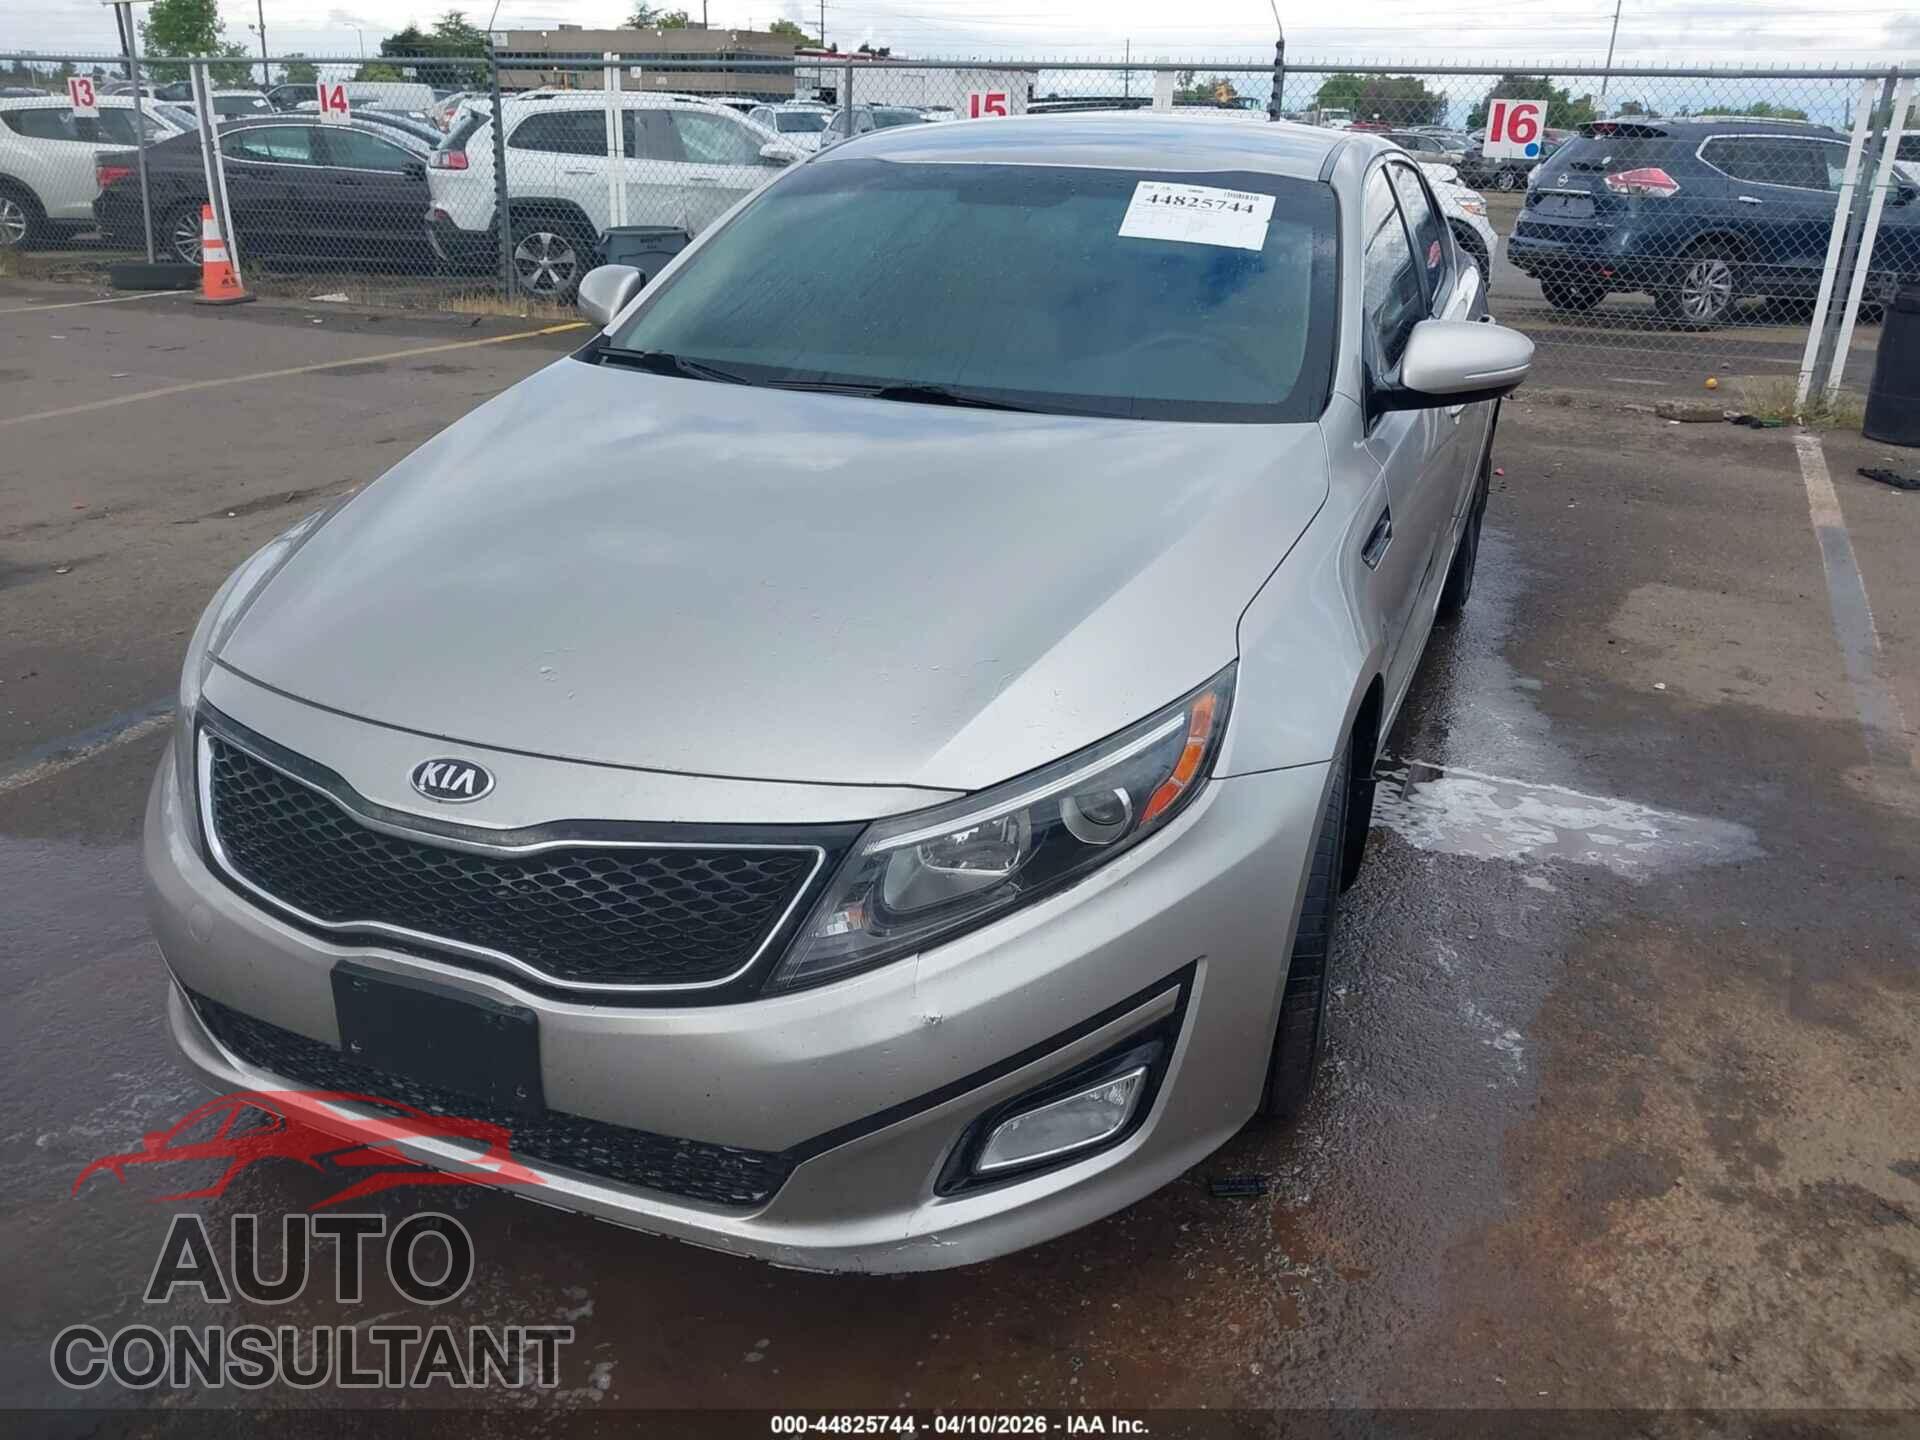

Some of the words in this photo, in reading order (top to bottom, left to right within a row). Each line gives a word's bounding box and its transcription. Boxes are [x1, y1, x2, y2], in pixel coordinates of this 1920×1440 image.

[71, 79, 95, 107] 13
[320, 84, 347, 113] 14
[971, 94, 1006, 119] 15
[1490, 103, 1539, 144] 16
[1146, 193, 1254, 214] 44825744
[418, 761, 476, 794] KIA
